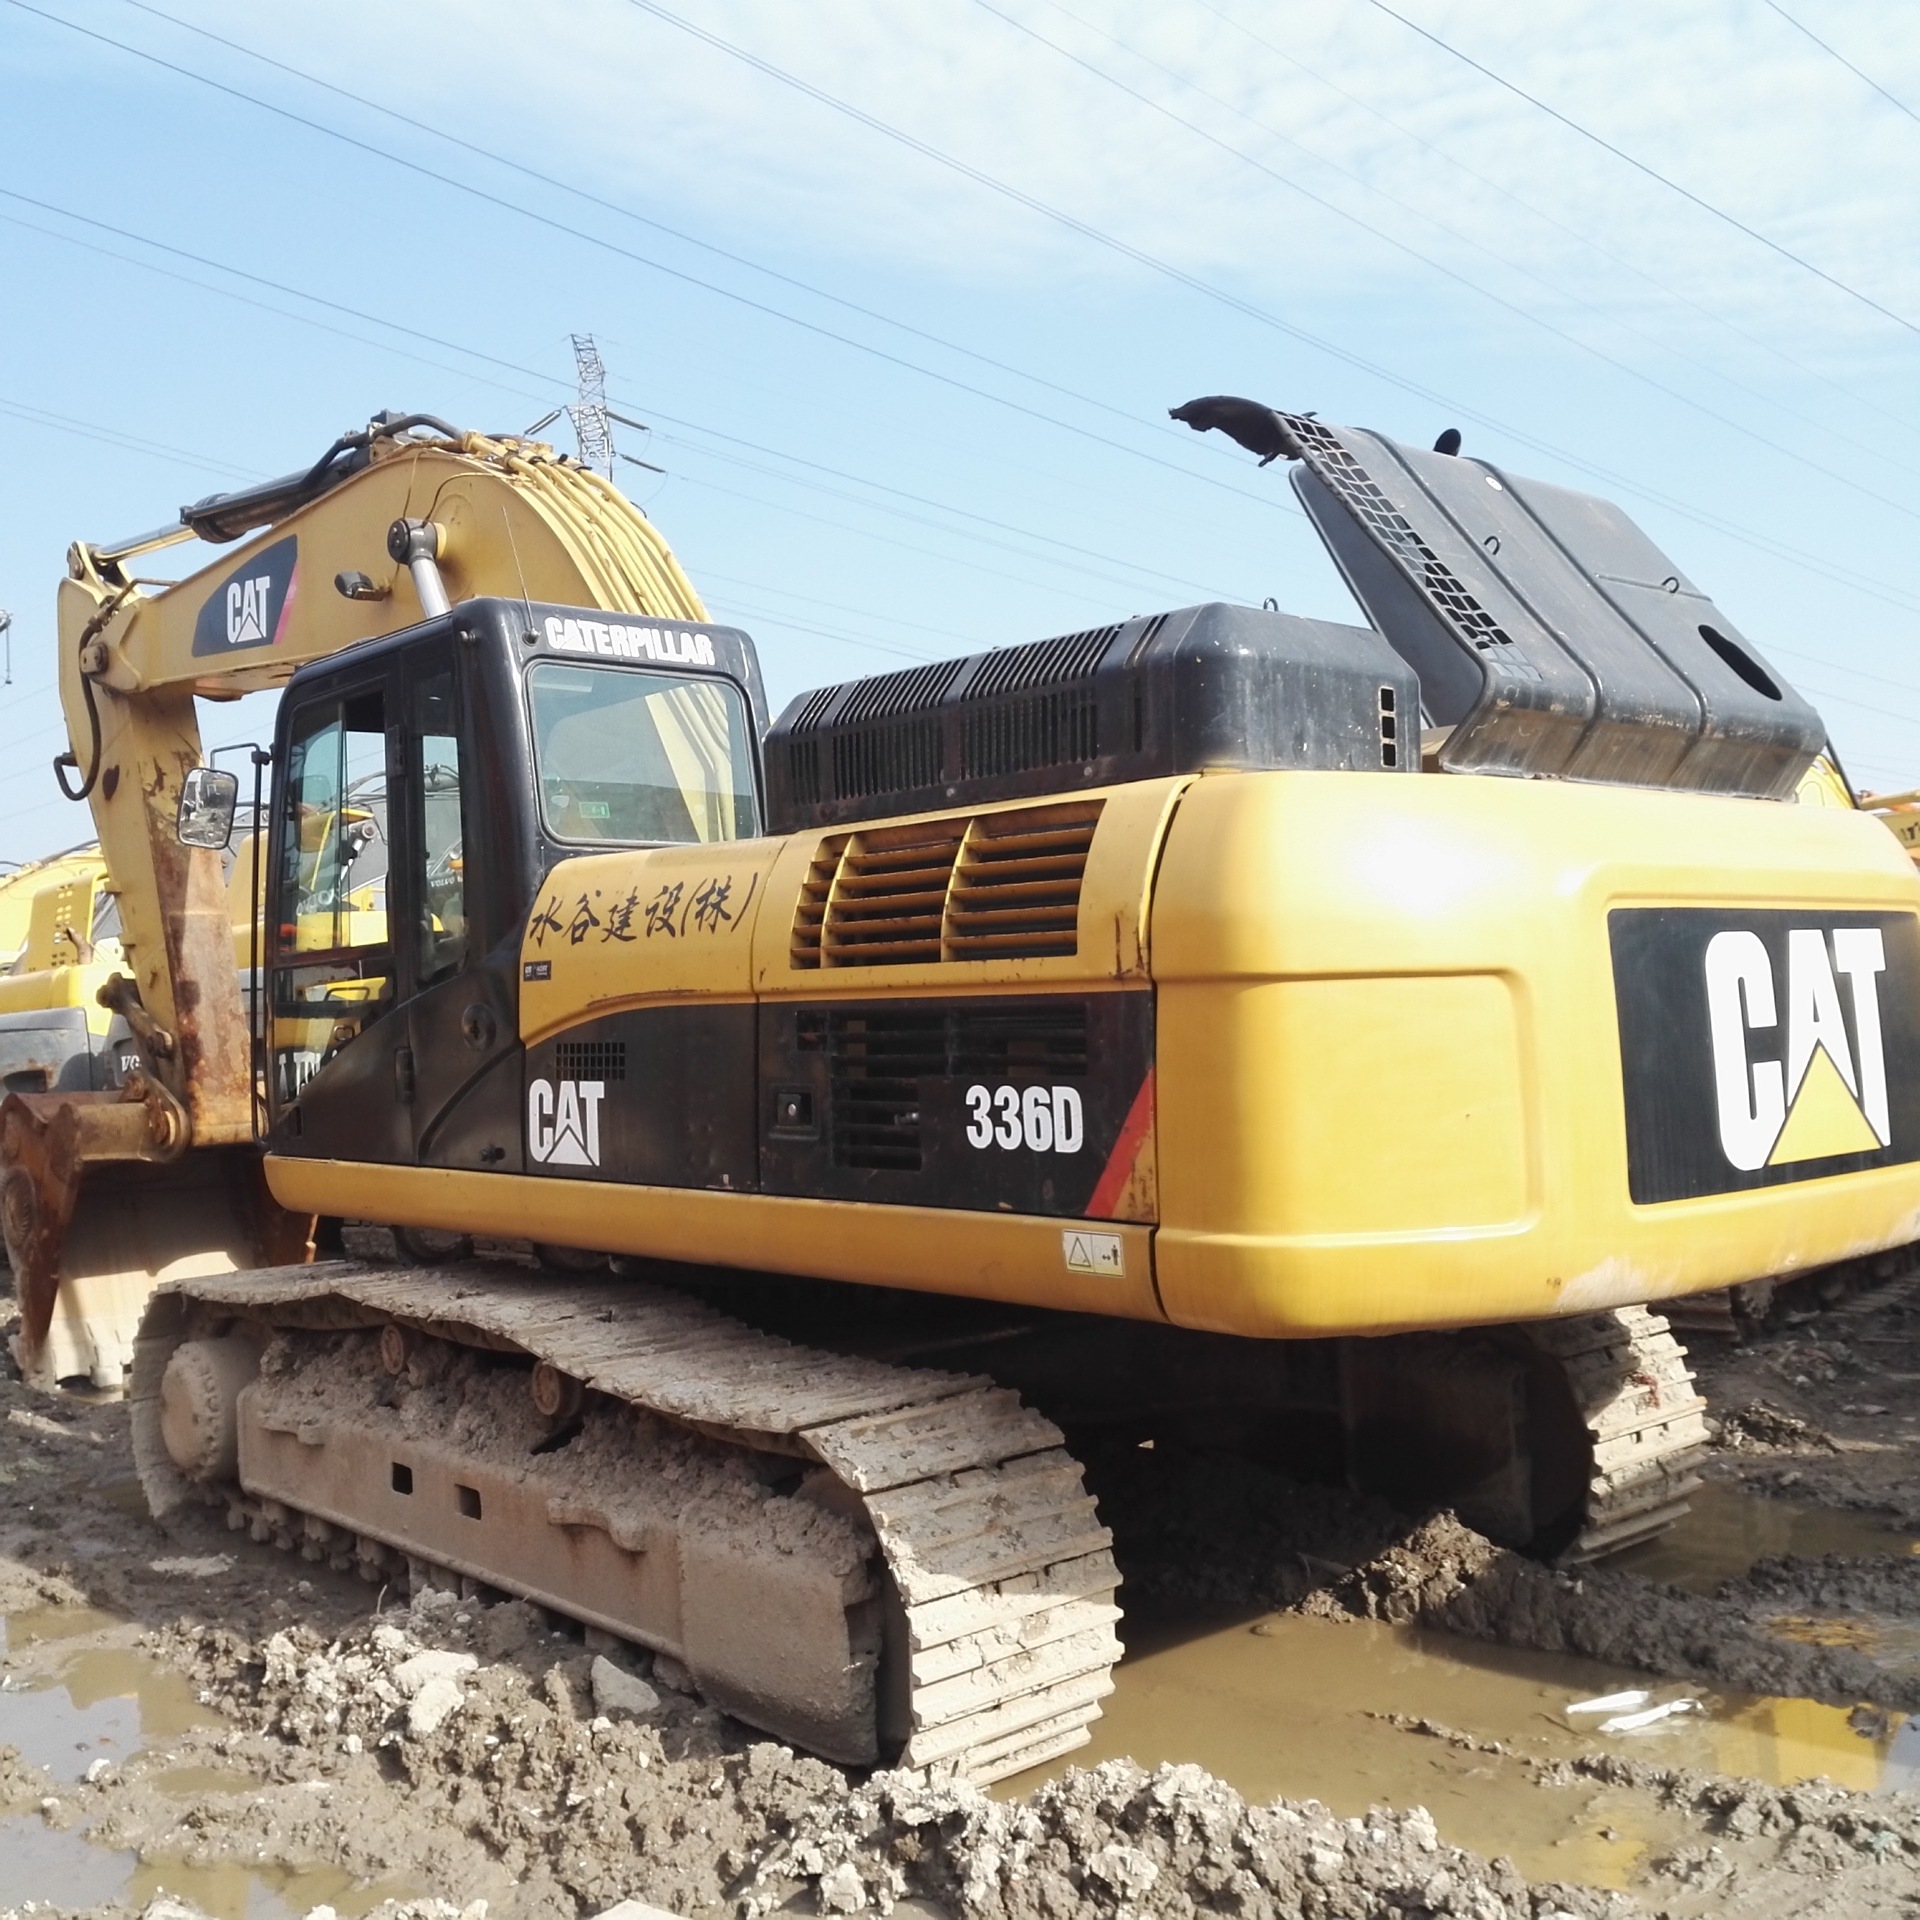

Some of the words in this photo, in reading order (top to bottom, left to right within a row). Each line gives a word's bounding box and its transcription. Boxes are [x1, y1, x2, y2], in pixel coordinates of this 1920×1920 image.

[227, 575, 271, 644] CAT
[544, 616, 716, 667] CATERPILLAR
[1704, 928, 1892, 1171] CAT
[529, 1078, 605, 1167] CAT
[965, 1084, 1084, 1154] 336D
